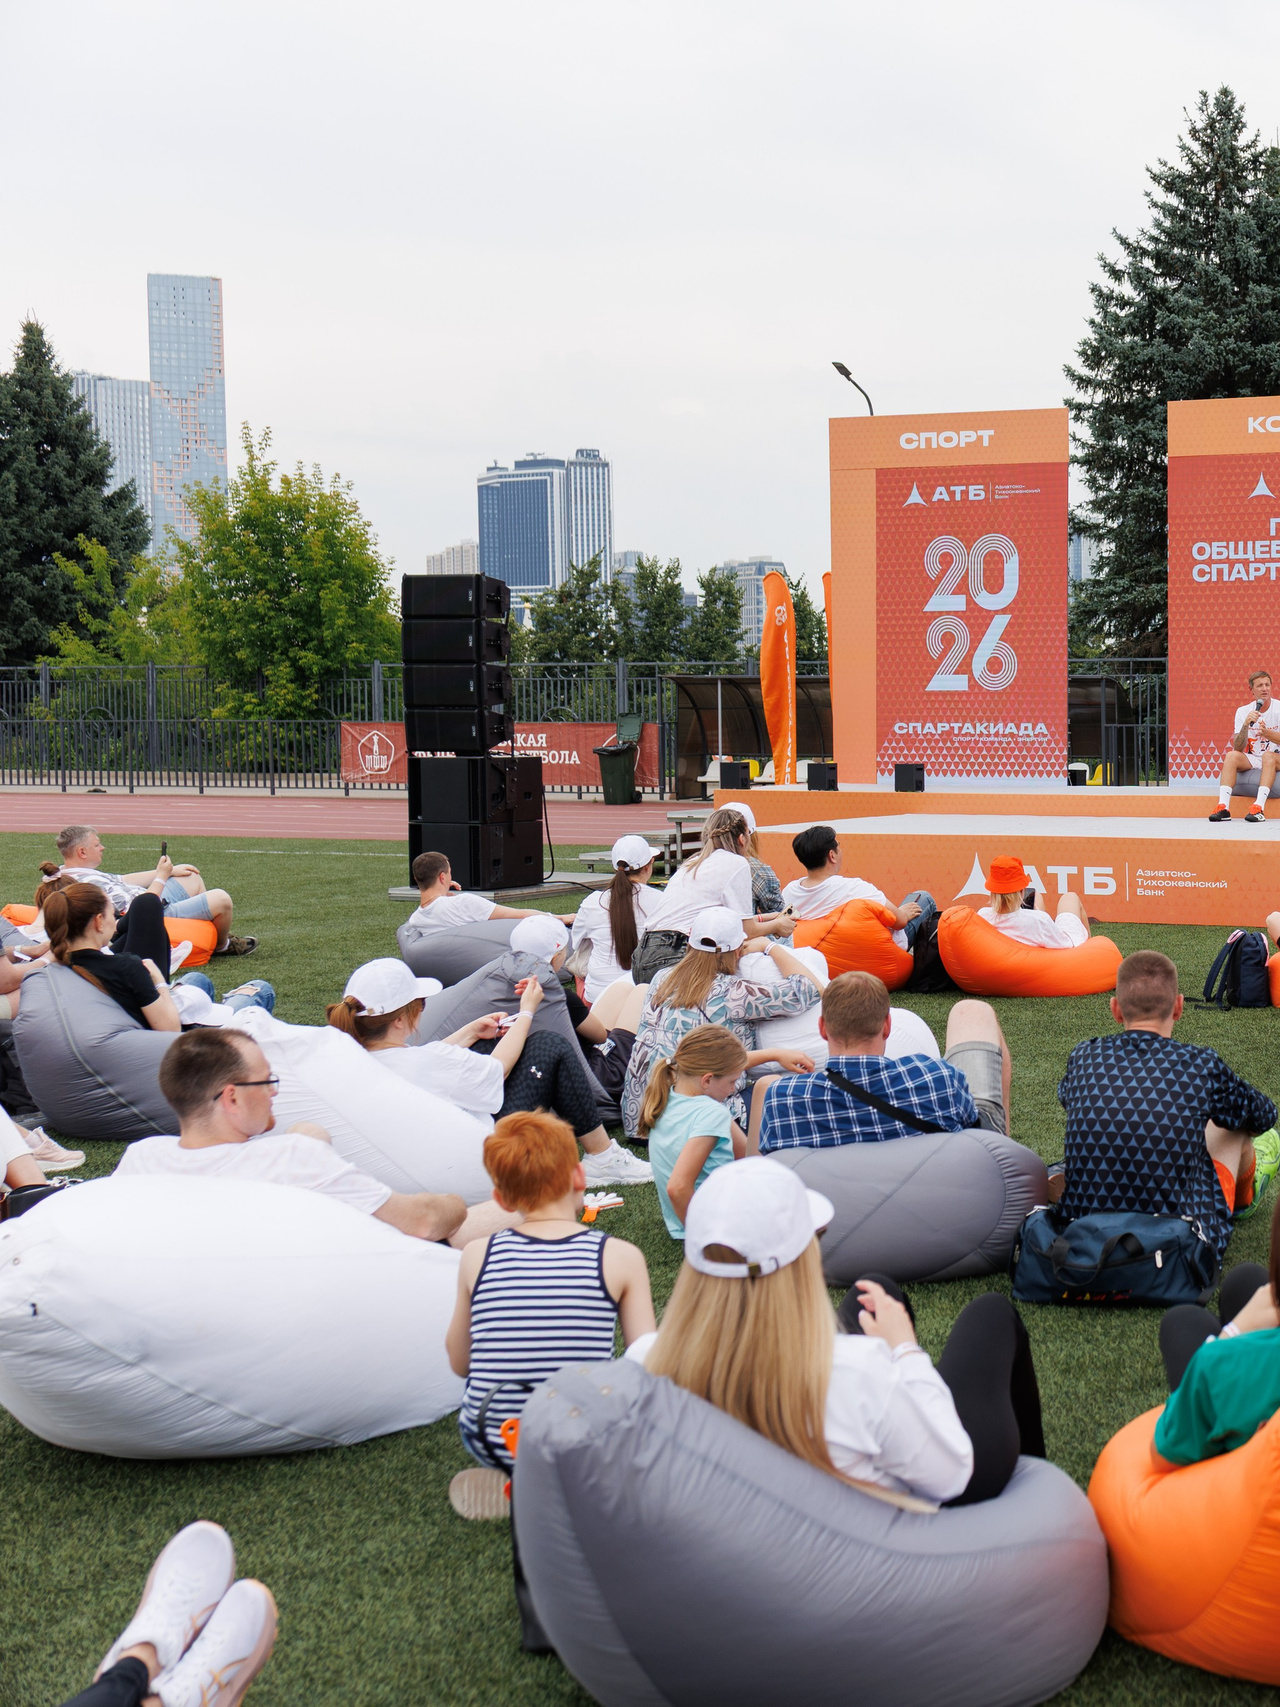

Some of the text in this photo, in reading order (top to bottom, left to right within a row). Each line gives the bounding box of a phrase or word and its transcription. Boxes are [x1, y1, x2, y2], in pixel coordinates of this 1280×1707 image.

[899, 429, 994, 450] СПОРТ
[931, 485, 986, 502] АТБ
[923, 533, 1020, 612] 20
[924, 614, 1018, 691] 26
[893, 722, 1049, 736] СПАРТАКИАДА
[1021, 865, 1117, 895] АТБ
[1136, 868, 1197, 877] Азиатско-
[1136, 878, 1228, 888] Тихоокеанский
[1136, 888, 1165, 897] Банк
